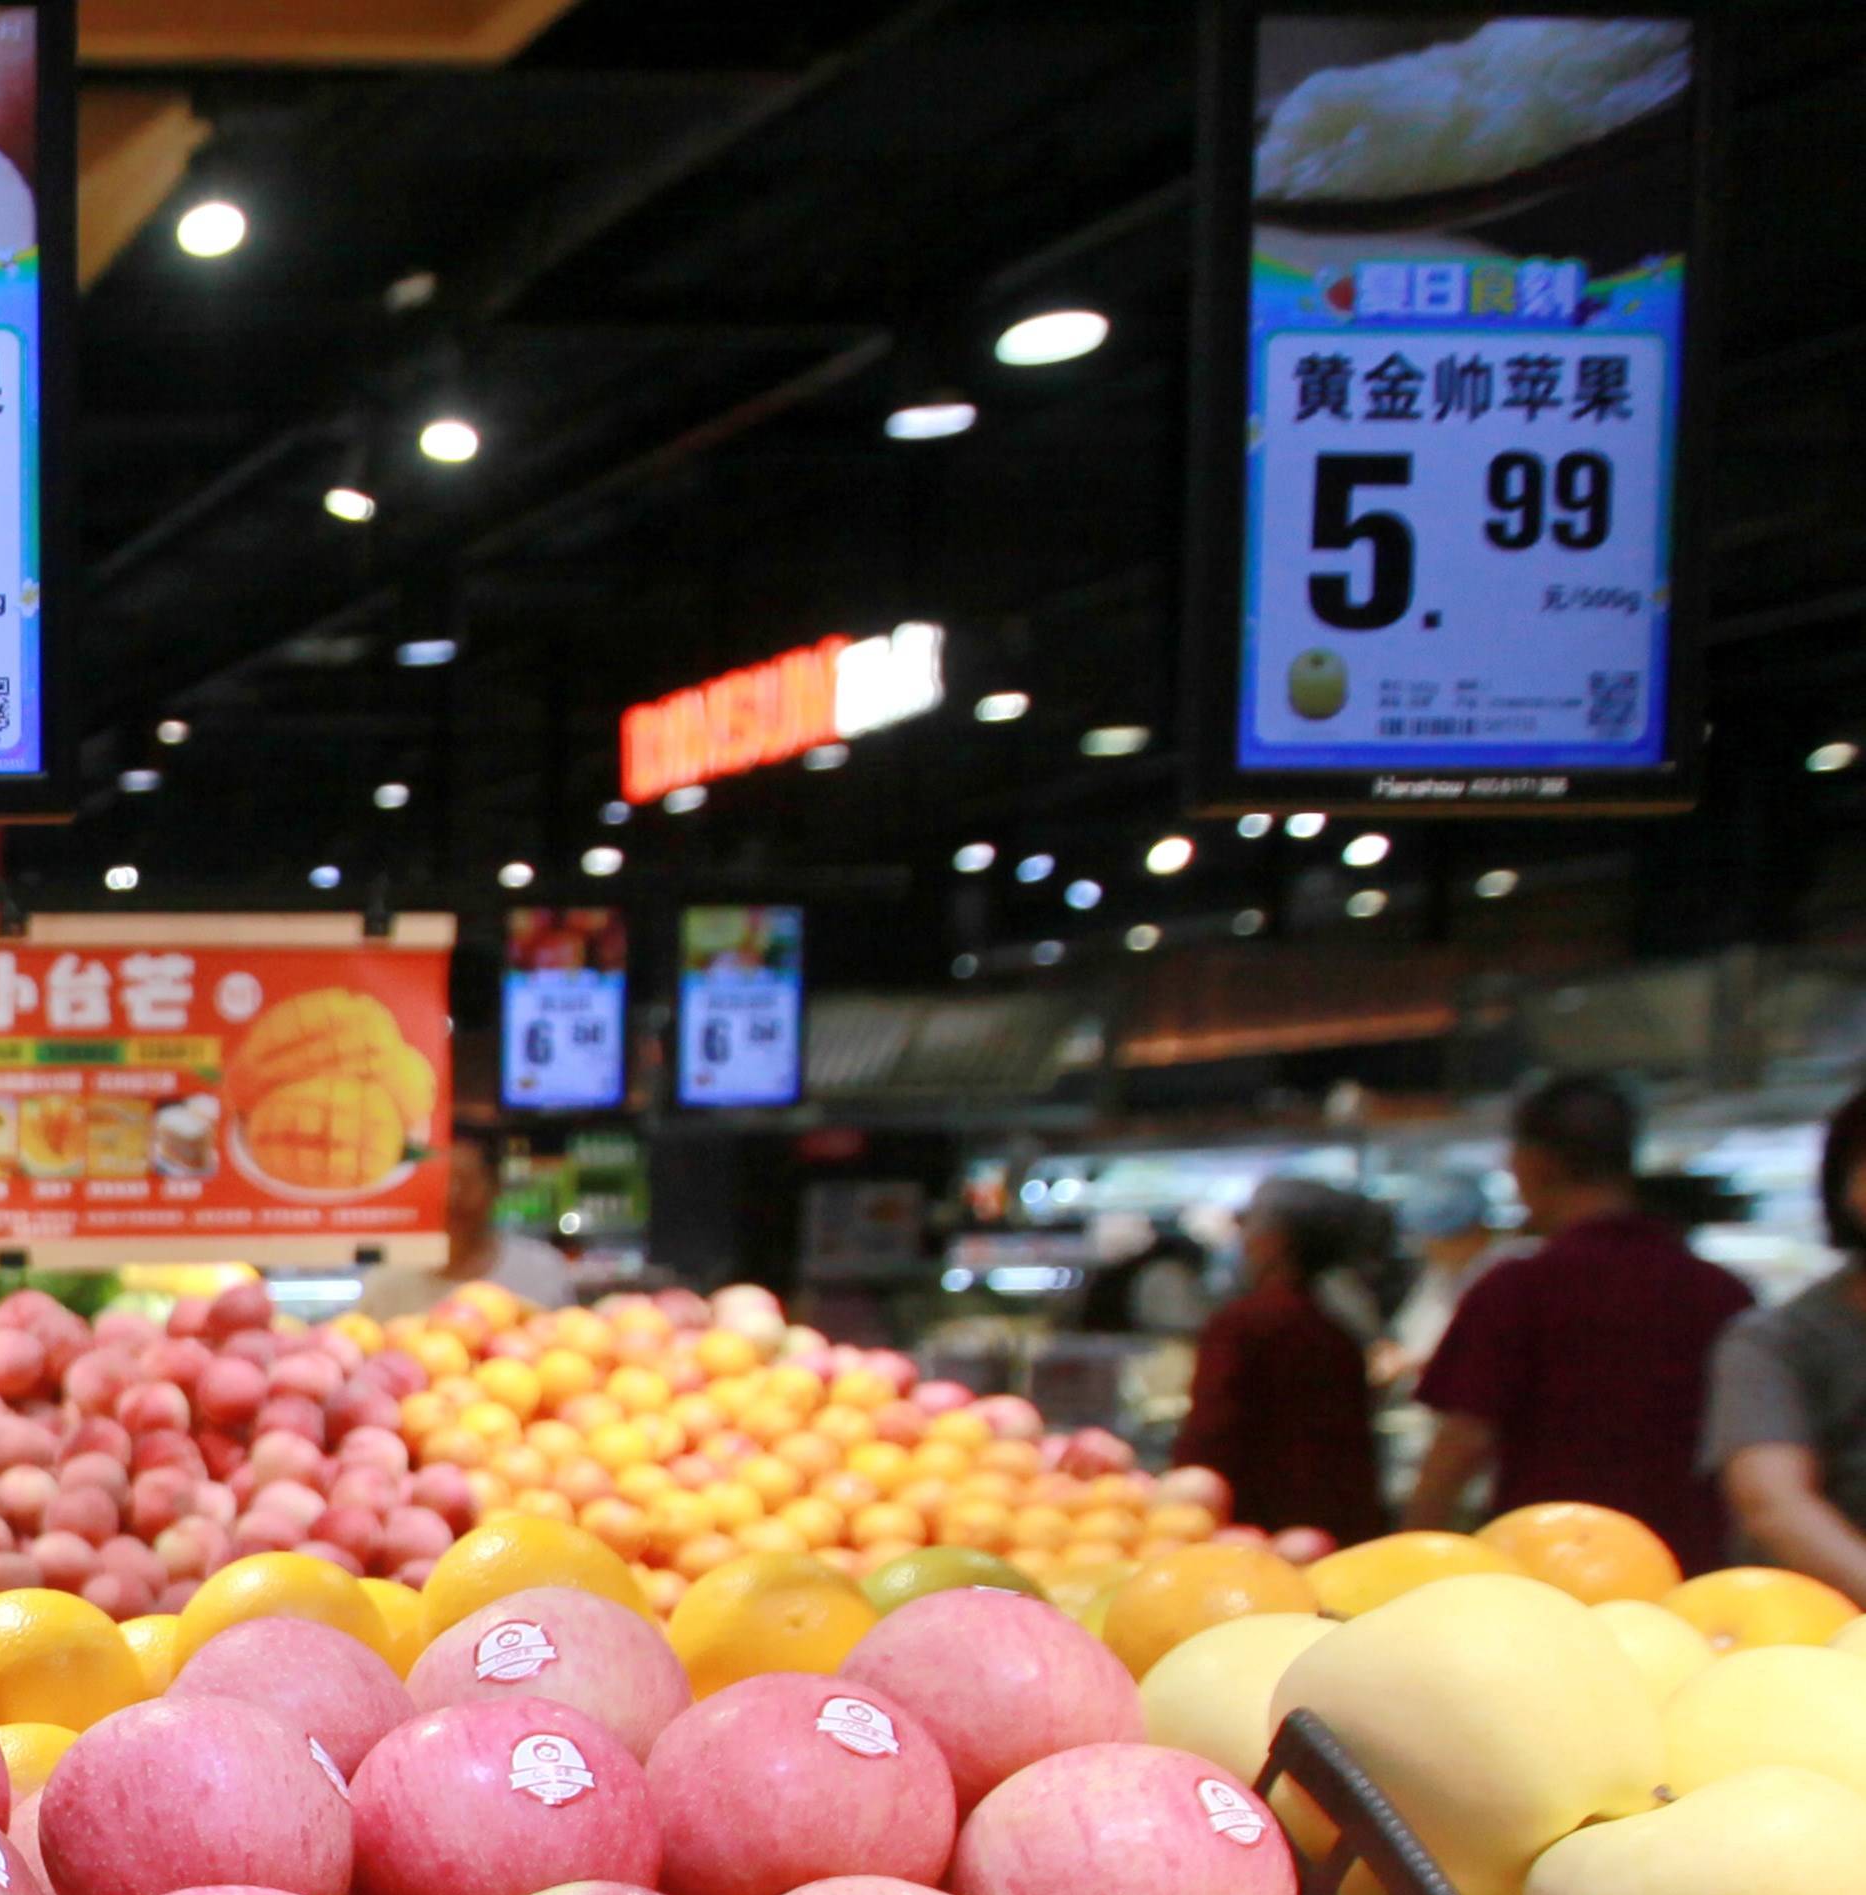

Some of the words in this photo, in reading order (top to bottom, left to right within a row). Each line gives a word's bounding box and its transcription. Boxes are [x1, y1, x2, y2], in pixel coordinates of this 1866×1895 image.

[1294, 354, 1634, 423] 黄金帅苹果
[1485, 449, 1610, 551] 99
